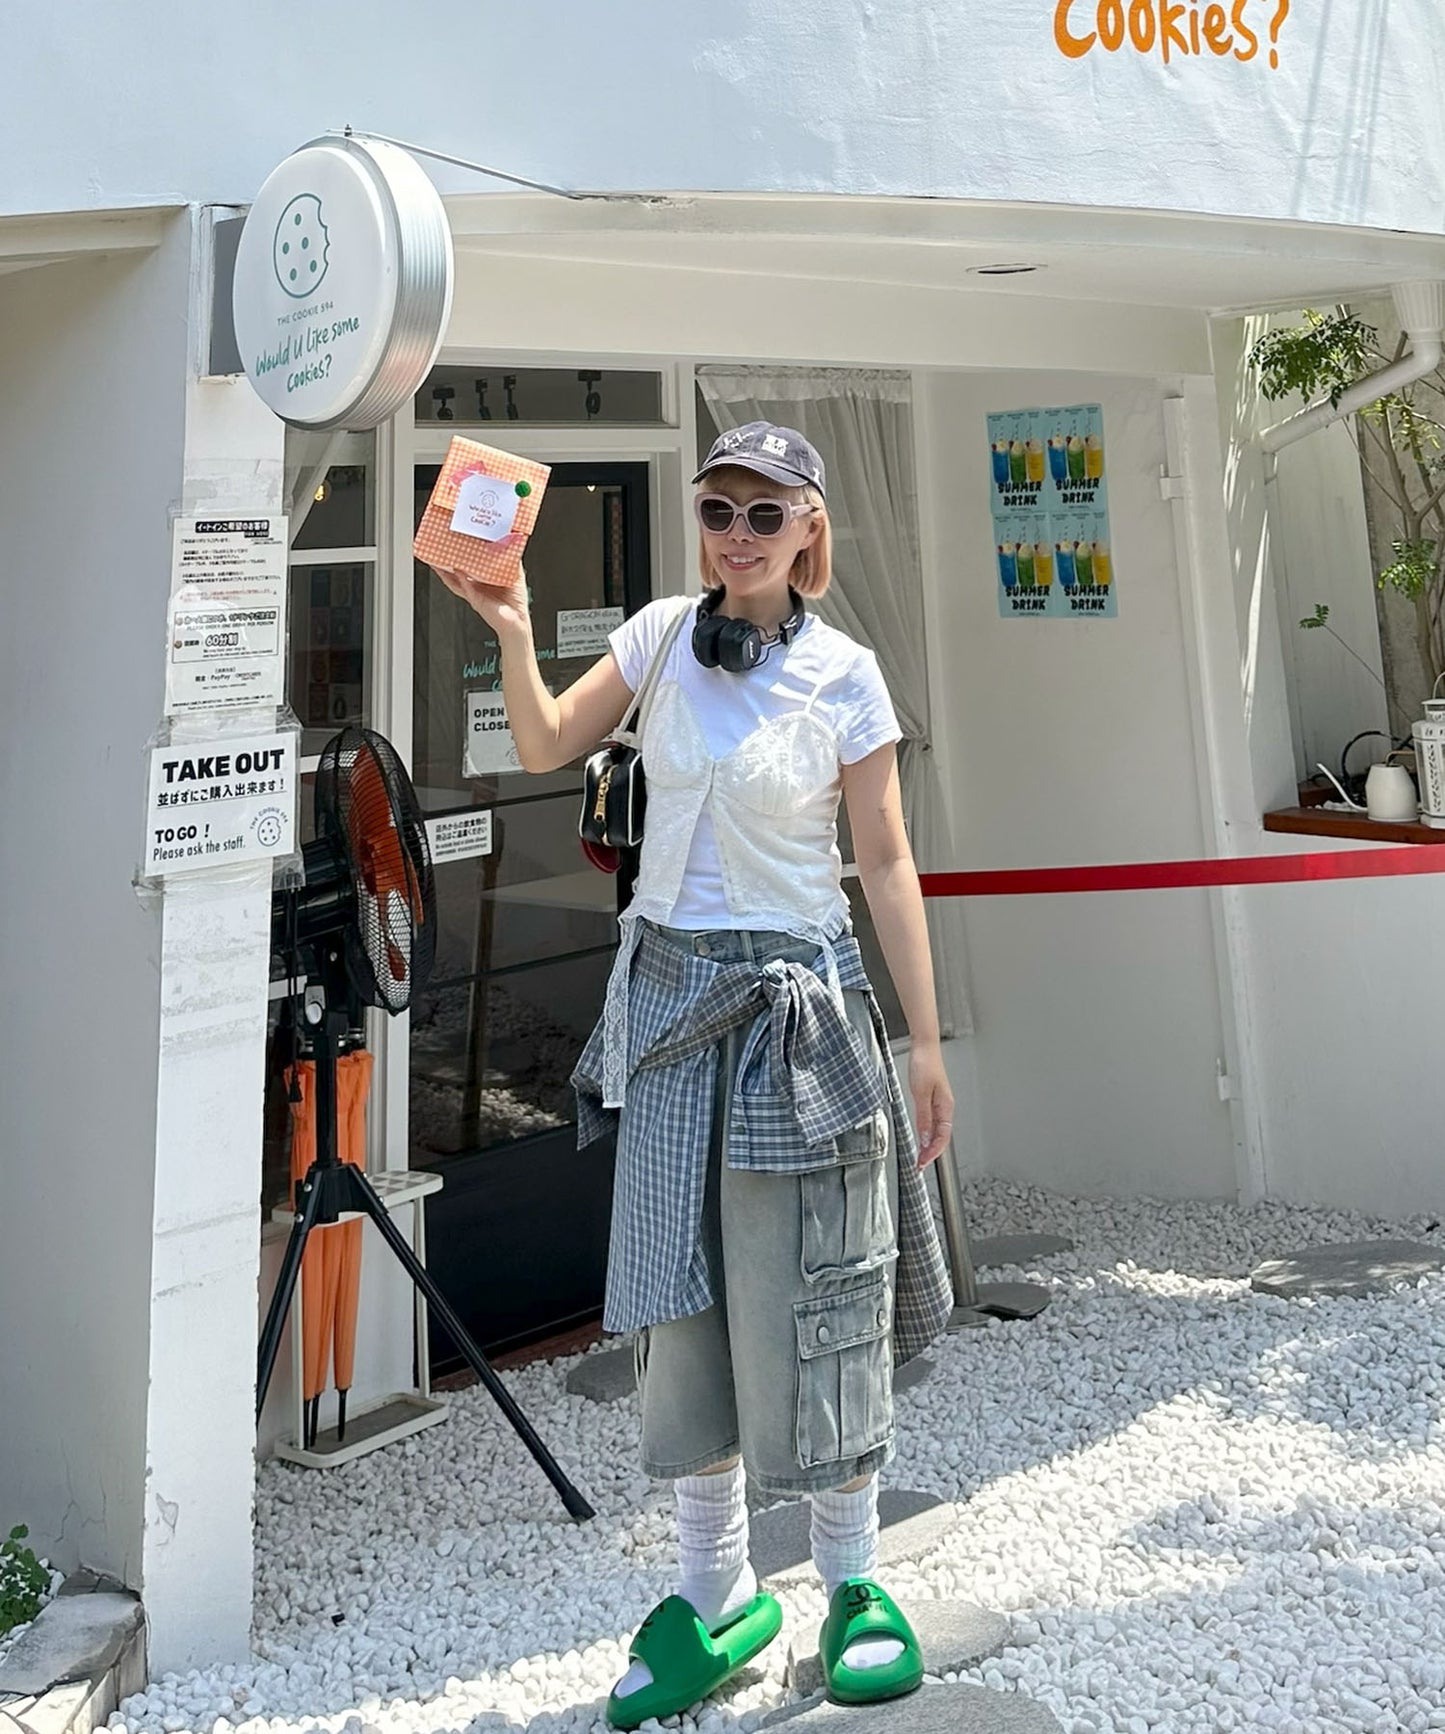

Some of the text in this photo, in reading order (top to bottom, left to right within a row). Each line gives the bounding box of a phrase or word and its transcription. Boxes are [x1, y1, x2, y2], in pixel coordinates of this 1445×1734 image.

[277, 301, 334, 327] THE COOKIE 594
[255, 335, 291, 377] Would
[998, 480, 1042, 493] SUMMER
[1056, 477, 1100, 491] SUMMER
[1003, 494, 1038, 506] DRINK
[1062, 491, 1095, 504] DRINK
[1005, 585, 1050, 598] SUMMER
[1064, 584, 1109, 597] SUMMER
[1012, 599, 1046, 611] DRINK
[1071, 599, 1105, 611] DRINK
[211, 674, 231, 682] PayPay
[474, 707, 505, 718] OPEN
[474, 720, 511, 732] CLOSE
[162, 749, 285, 783] TAKE OUT
[258, 807, 280, 818] COOKIE
[153, 835, 246, 861] Please ask the staff.
[847, 1604, 889, 1619] CHAEL
